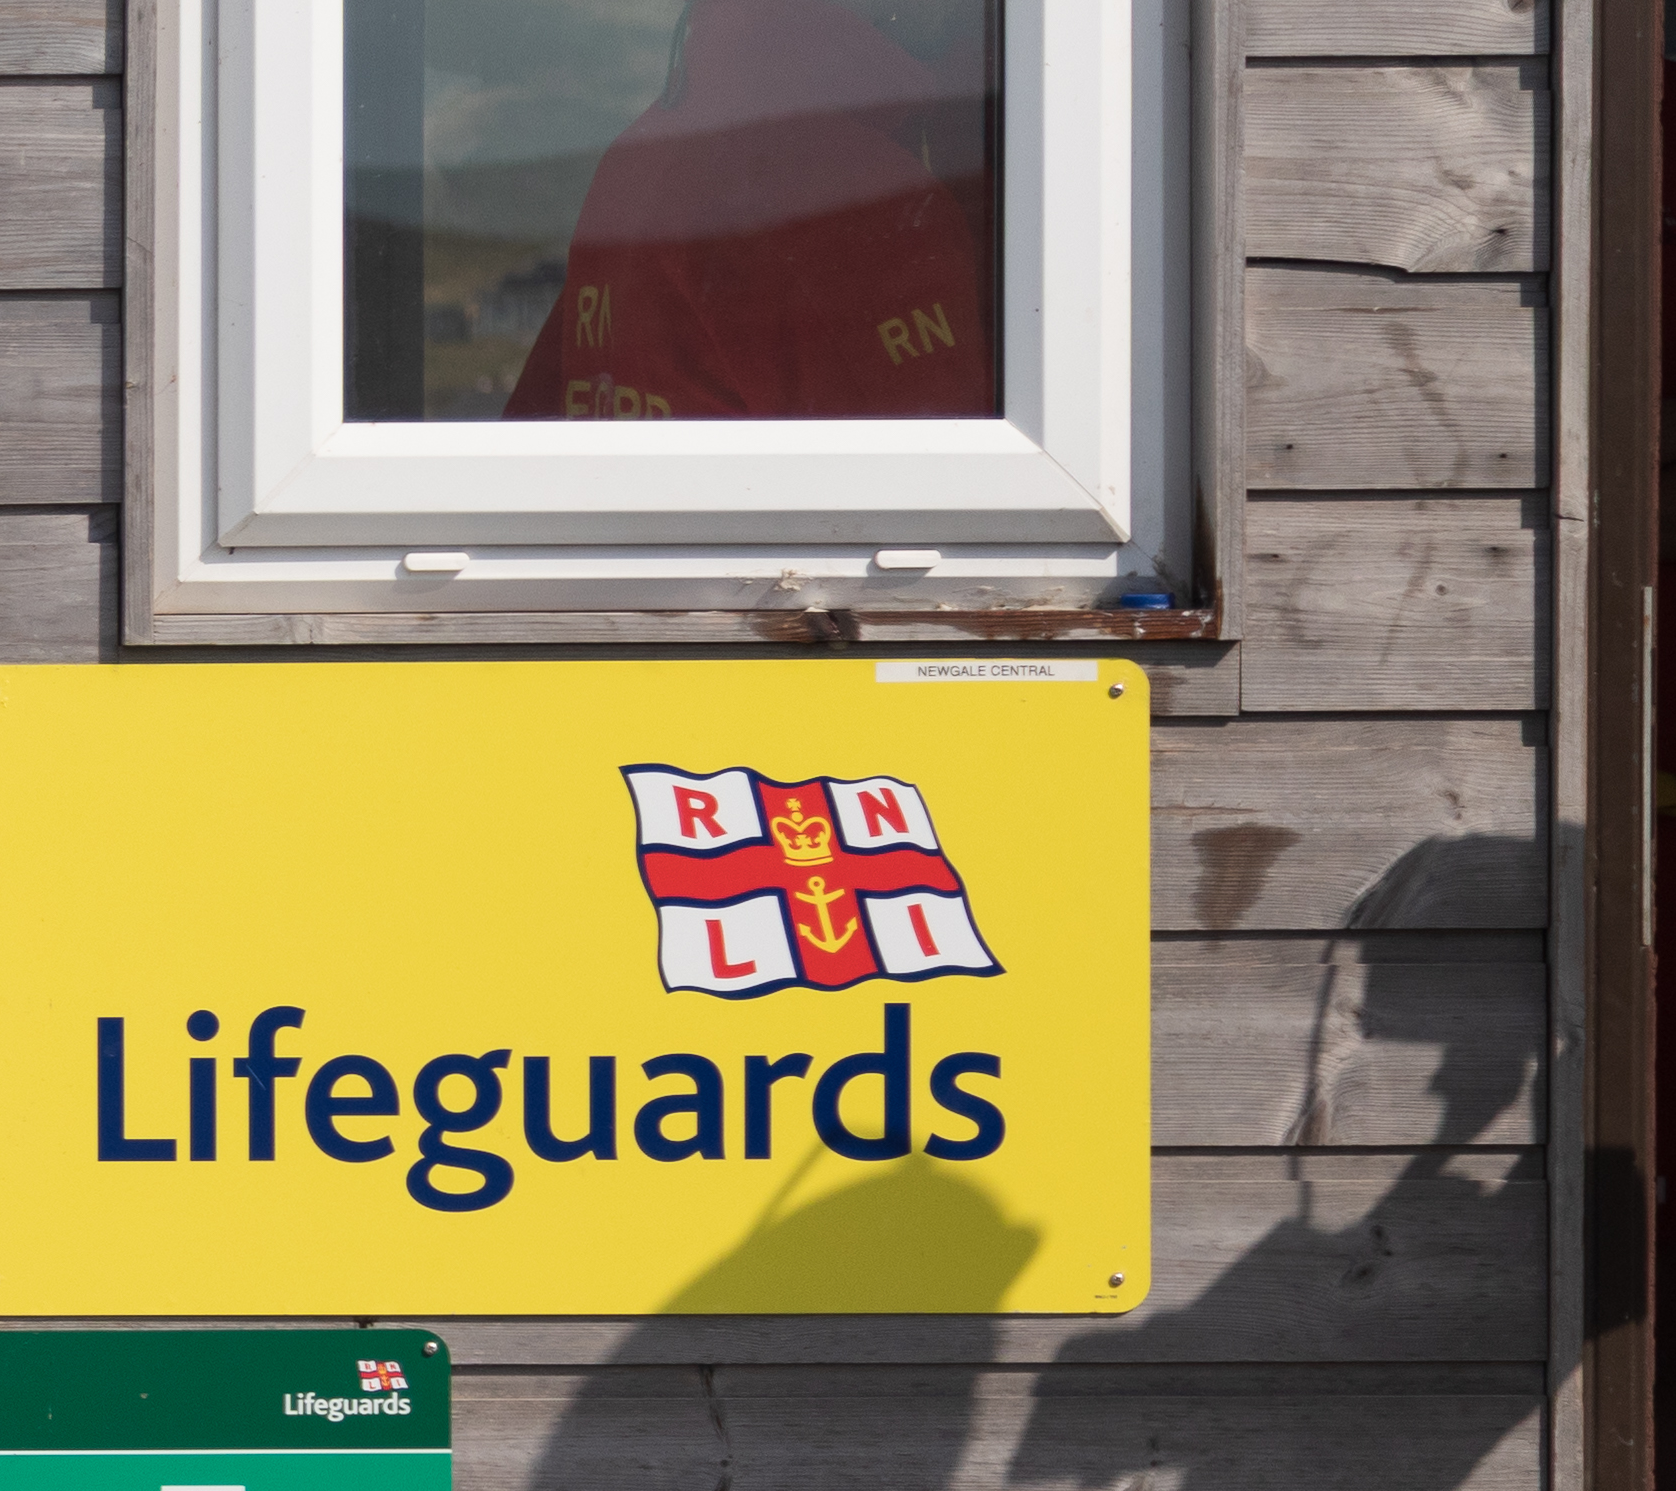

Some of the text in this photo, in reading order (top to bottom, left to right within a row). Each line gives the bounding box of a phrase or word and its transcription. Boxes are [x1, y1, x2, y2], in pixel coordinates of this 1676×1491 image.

[876, 302, 956, 366] RN
[917, 665, 1055, 677] NEWGALE CENTRAL
[96, 1001, 1006, 1212] Lifeguards
[284, 1392, 411, 1422] Lifeguards
